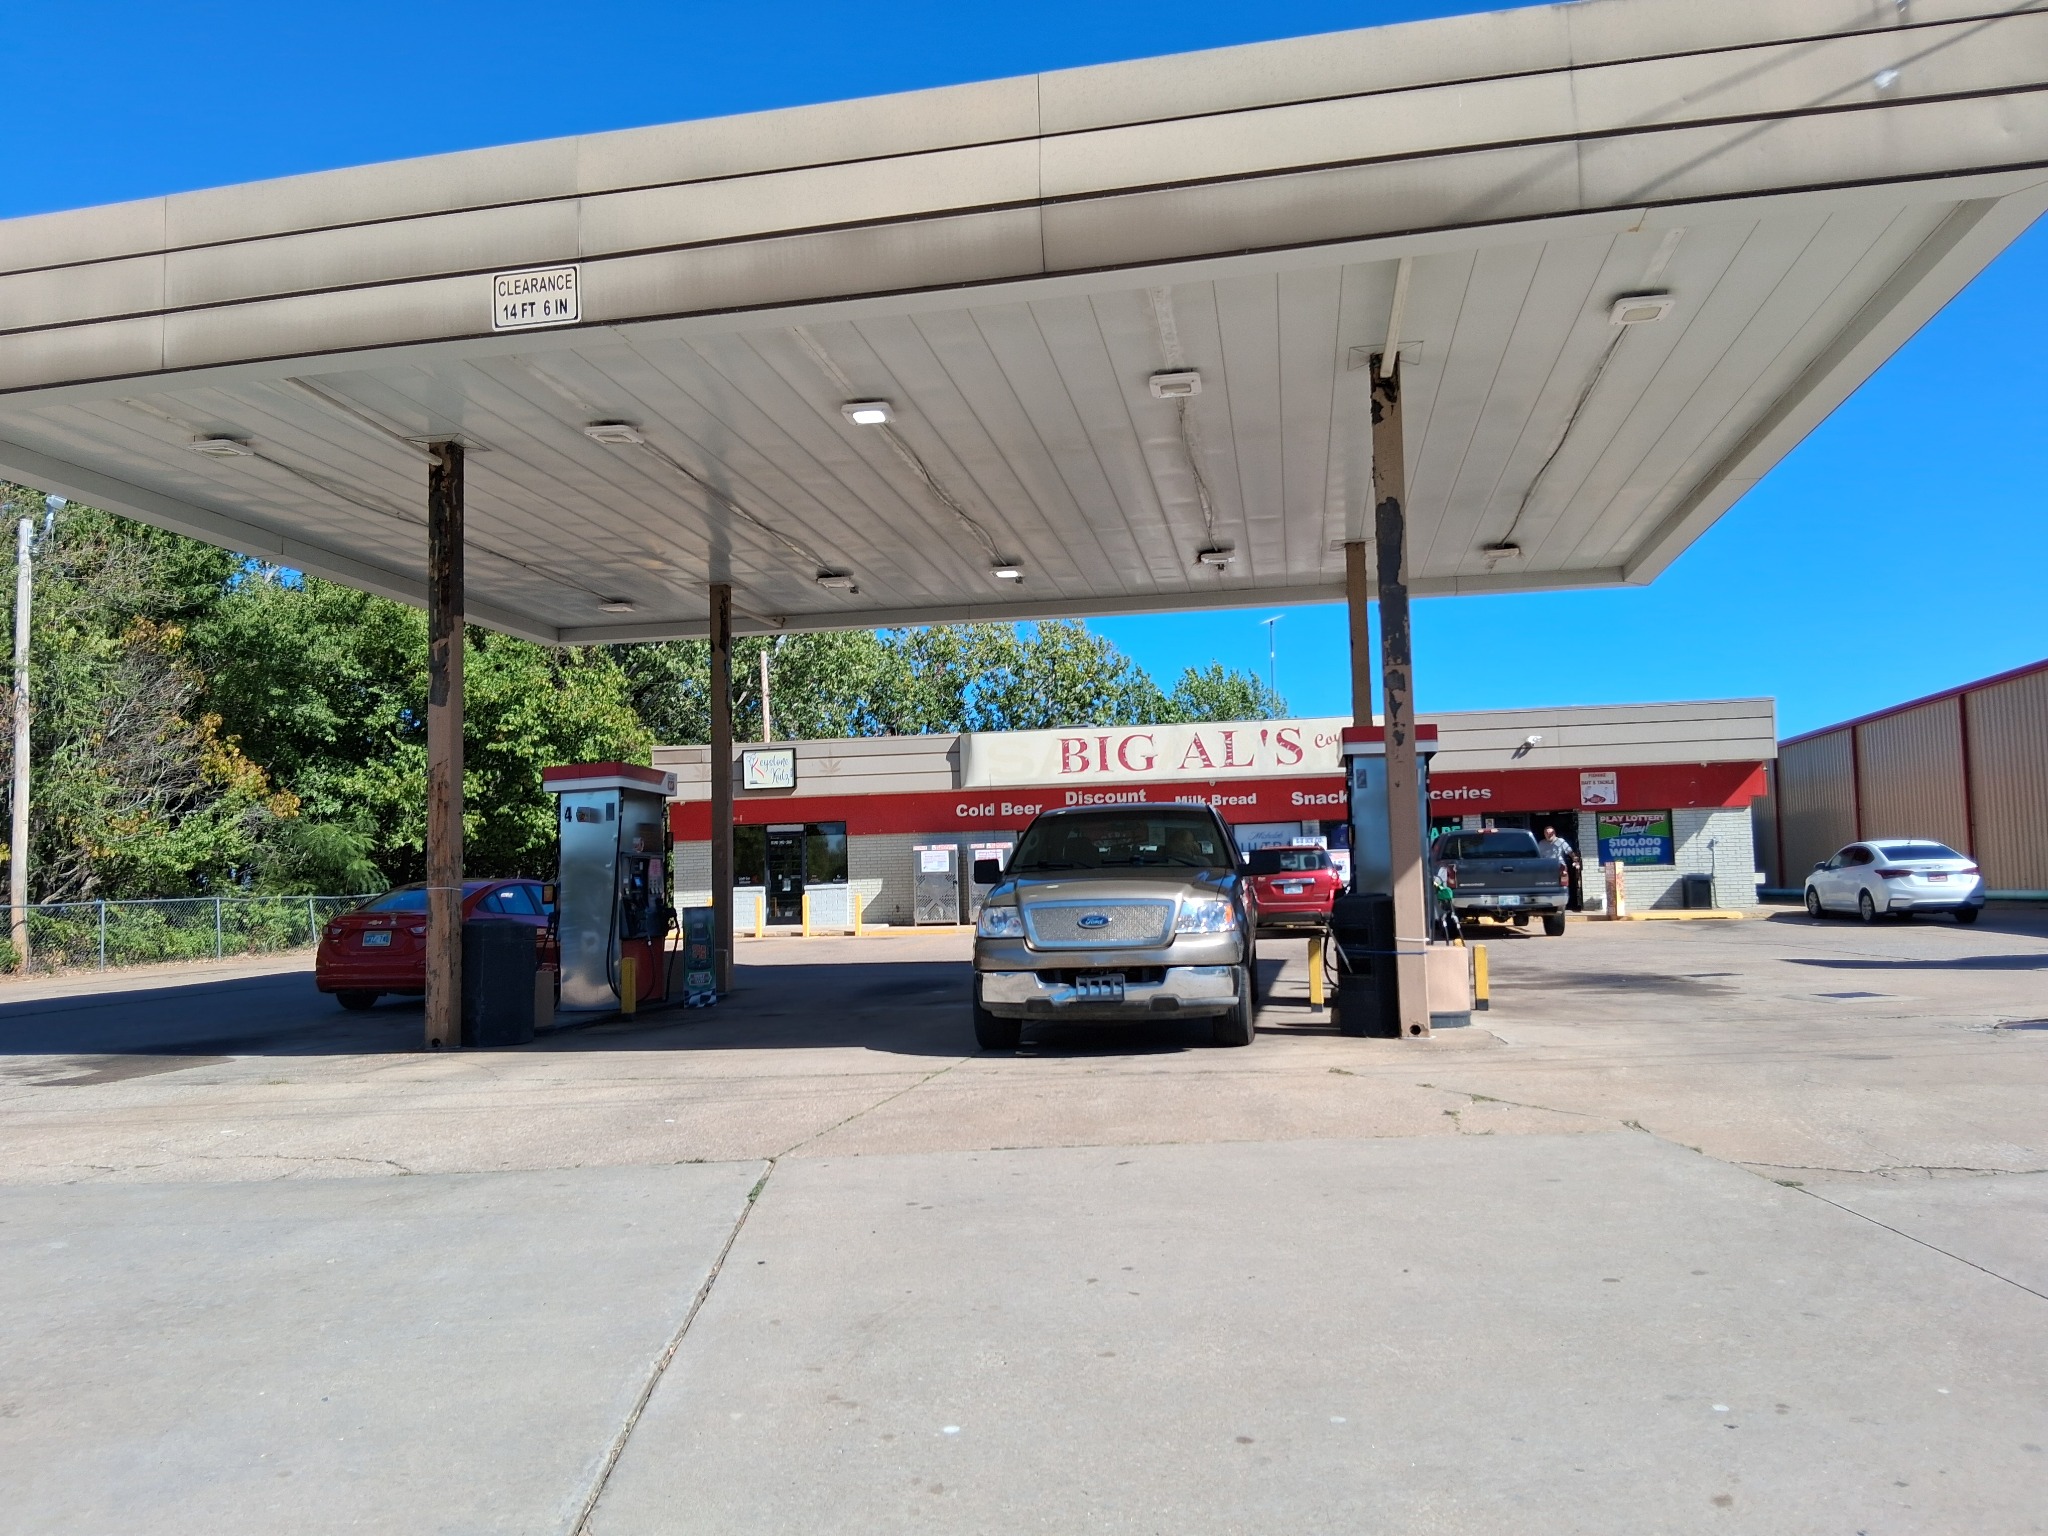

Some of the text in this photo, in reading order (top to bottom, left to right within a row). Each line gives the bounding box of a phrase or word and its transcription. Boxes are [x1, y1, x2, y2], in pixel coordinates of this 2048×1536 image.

[498, 273, 573, 297] CLEARANCE
[503, 298, 568, 320] 14 FT 6 IN
[1057, 733, 1158, 774] BIG
[1177, 727, 1304, 770] AL'S
[1065, 788, 1147, 805] Discount
[564, 806, 573, 822] 4
[956, 802, 1043, 817] Cold Beer
[1625, 814, 1666, 822] LOTTERY
[1620, 821, 1650, 834] Today!
[1608, 837, 1662, 848] $100,000
[1609, 847, 1661, 857] WINNER
